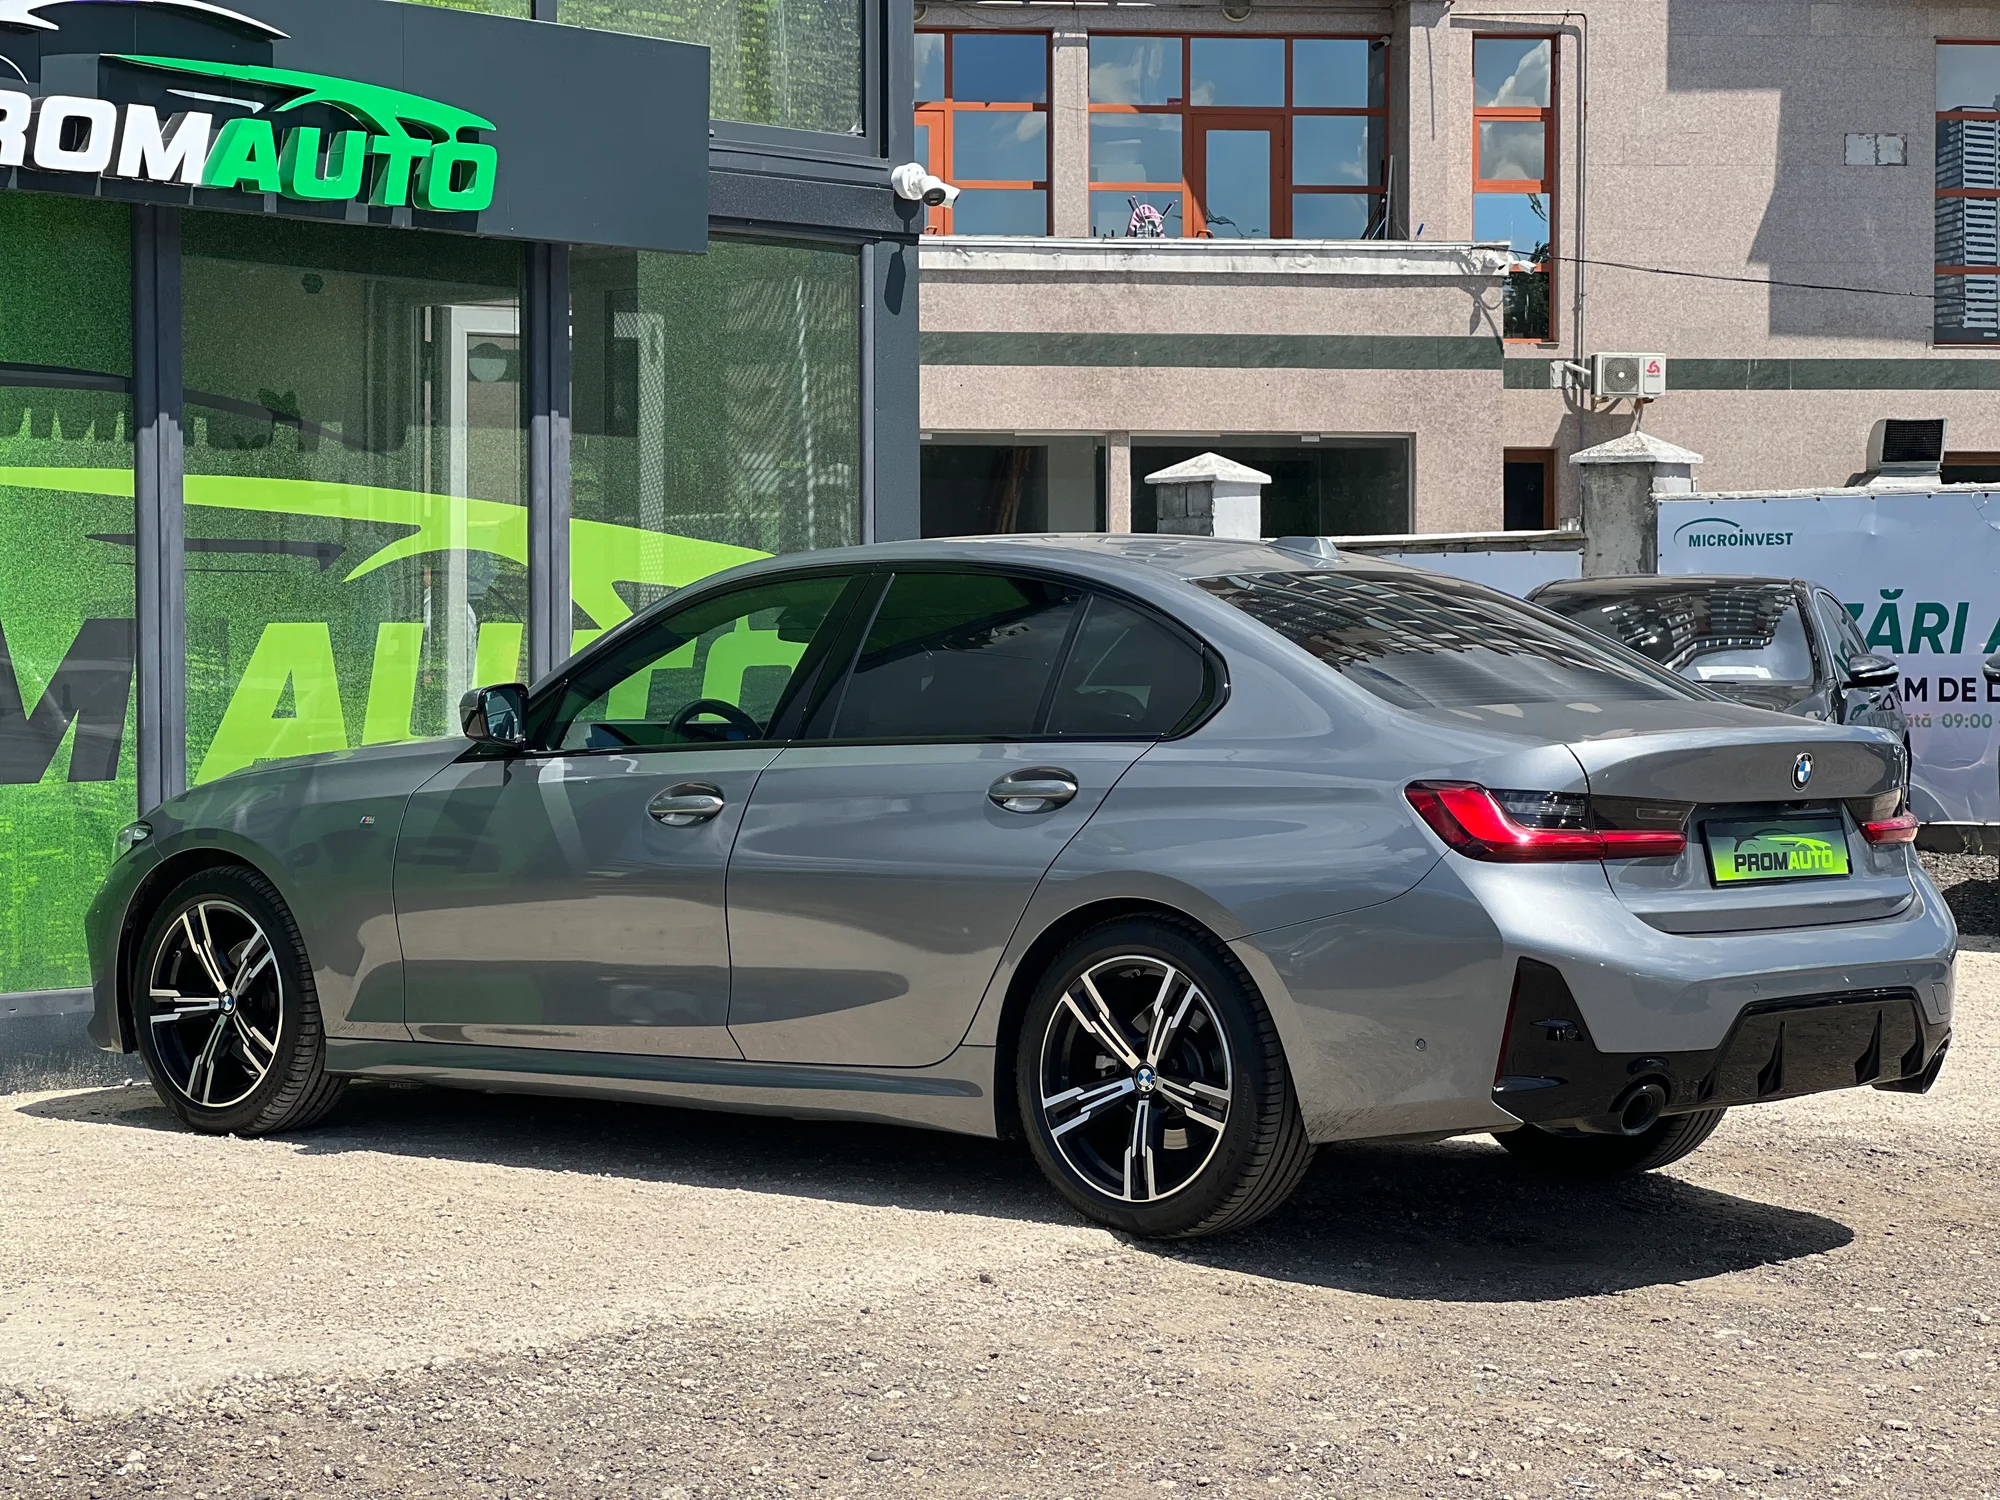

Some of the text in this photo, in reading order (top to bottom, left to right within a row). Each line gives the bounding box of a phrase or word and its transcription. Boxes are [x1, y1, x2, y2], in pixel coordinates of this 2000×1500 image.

[1938, 677, 1977, 702] DE
[1942, 713, 1993, 729] 09:00
[1733, 849, 1834, 873] PROMAUTO
